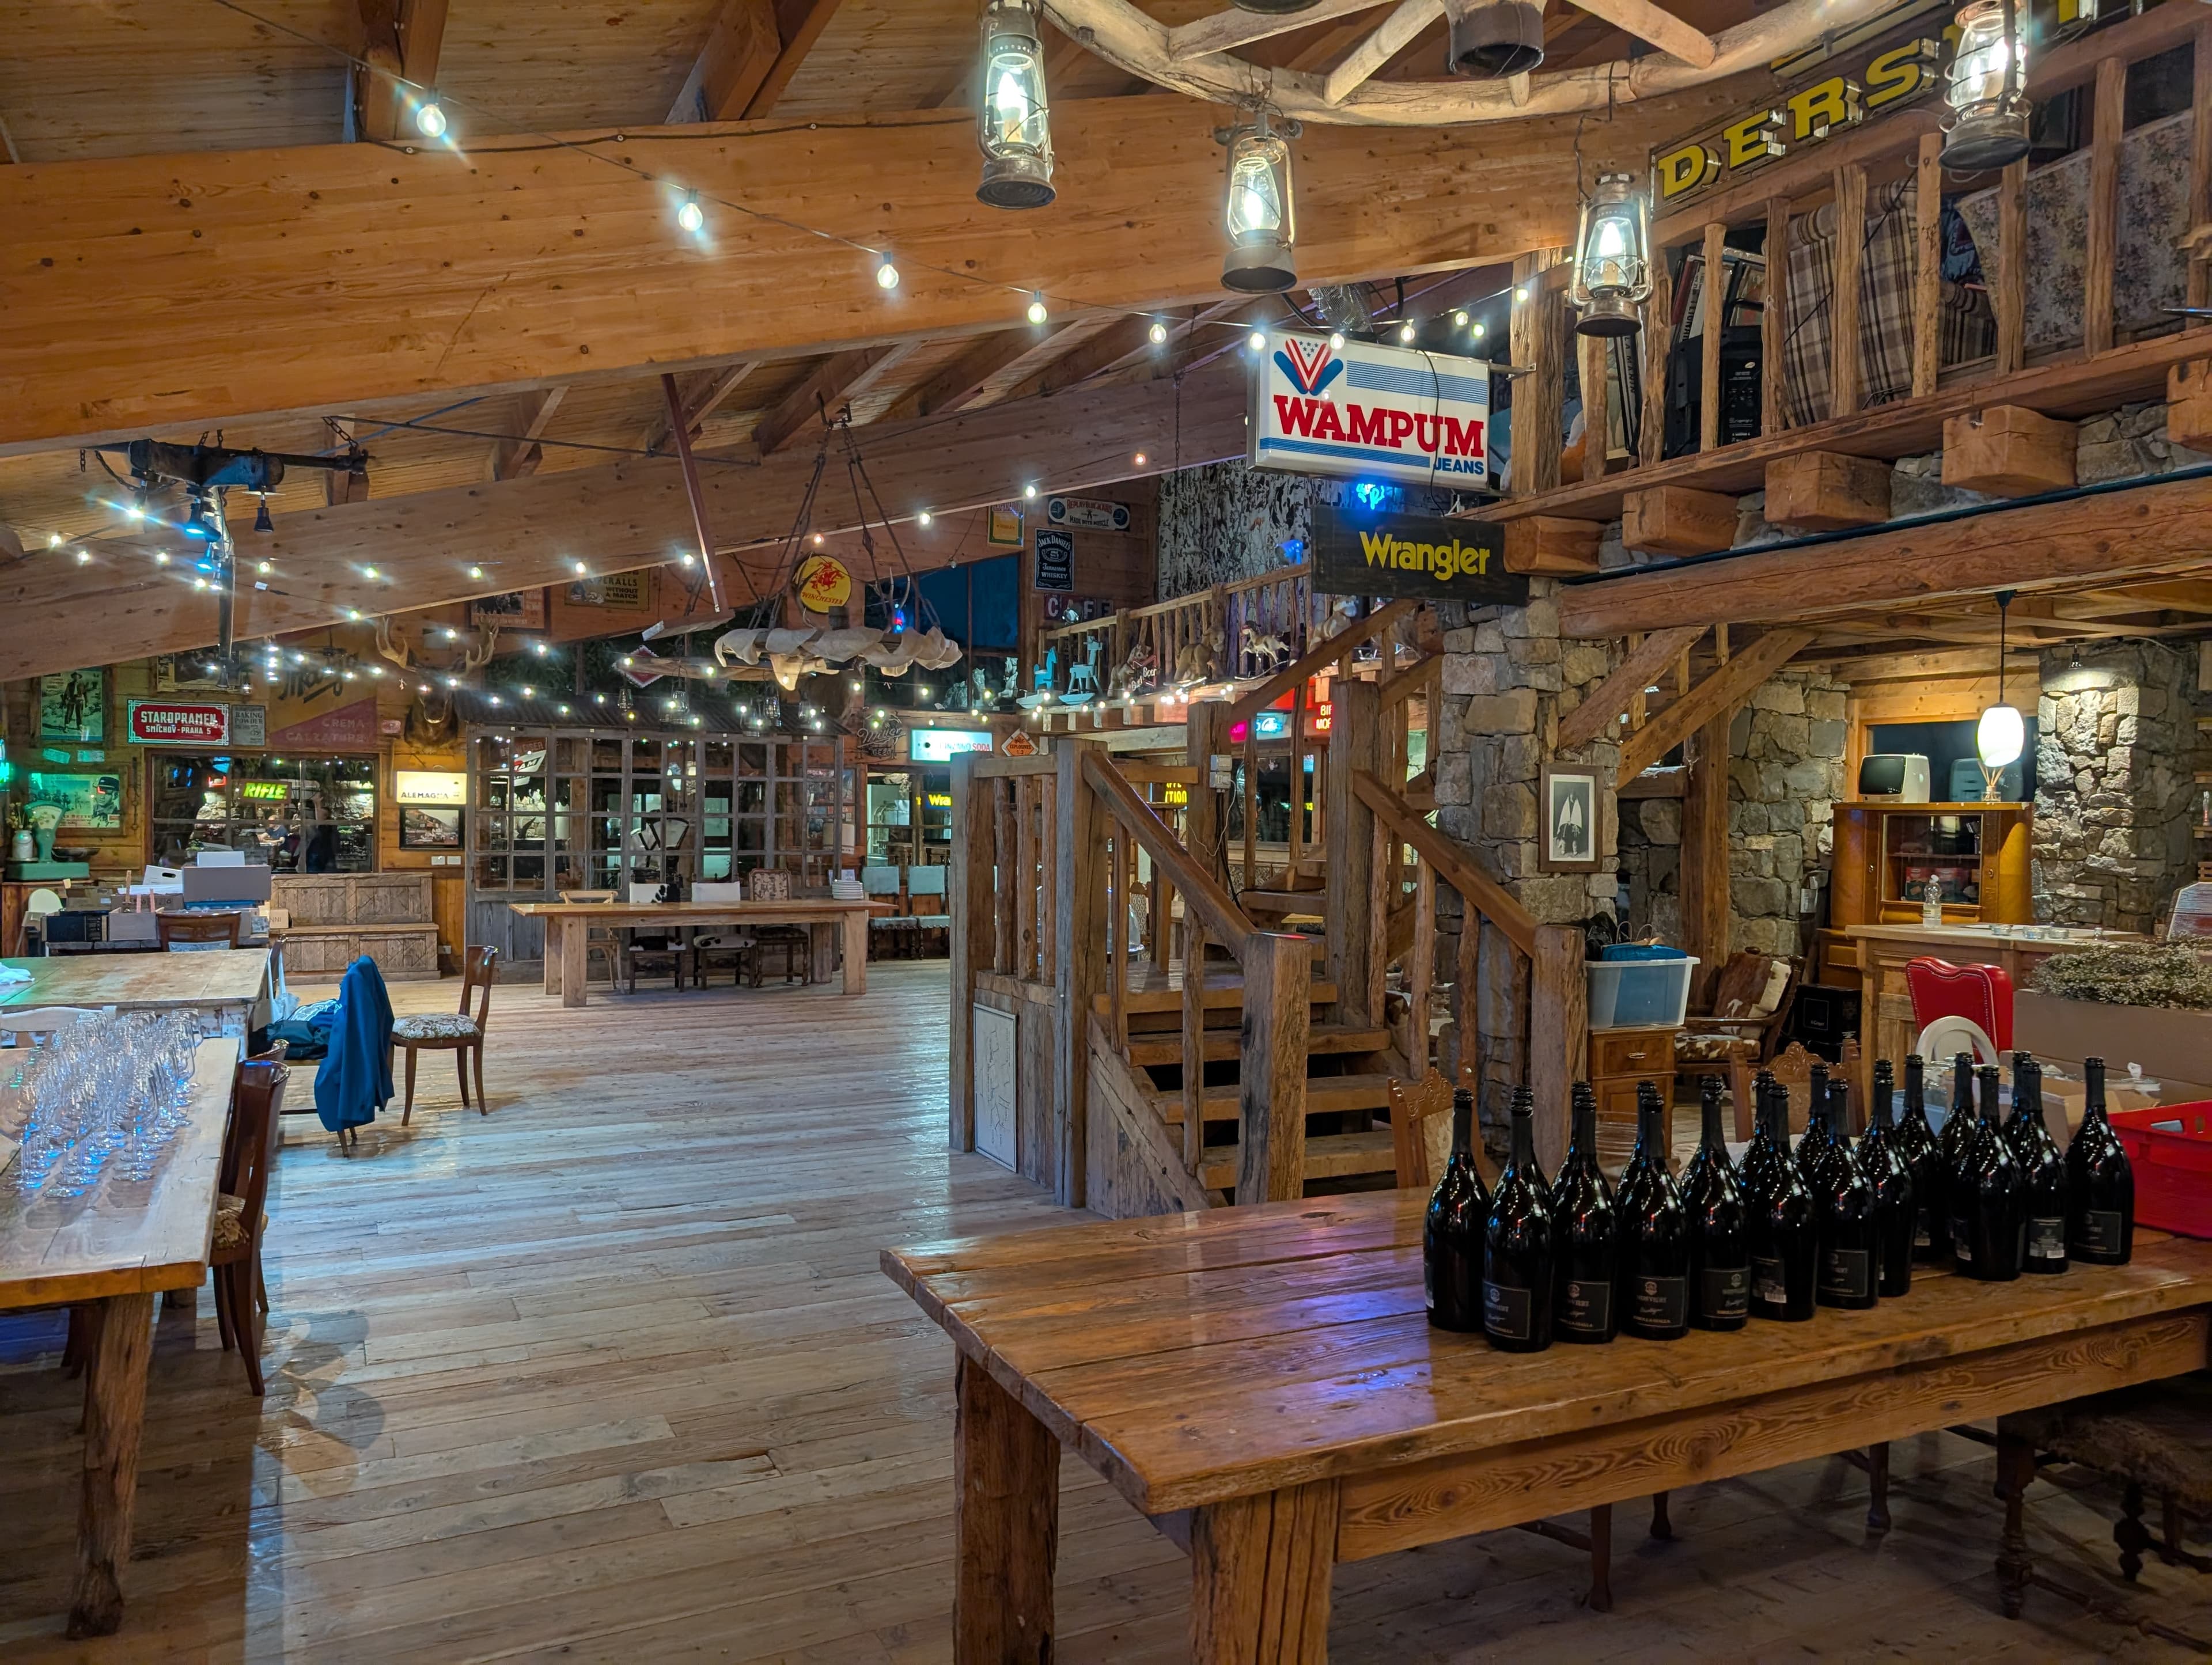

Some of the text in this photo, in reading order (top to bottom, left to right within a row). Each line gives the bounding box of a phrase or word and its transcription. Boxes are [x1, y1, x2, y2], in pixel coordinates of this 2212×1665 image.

[1274, 395, 1484, 457] WAMPUM
[1433, 457, 1484, 475] JEANS
[1038, 537, 1051, 548] JACK
[1359, 531, 1490, 581] Wrangler
[801, 592, 843, 605] WINCHESTER
[141, 711, 217, 726] STAROPRAMEN
[322, 720, 365, 729] CREMA
[857, 726, 903, 744] Miller
[972, 743, 990, 752] SODA
